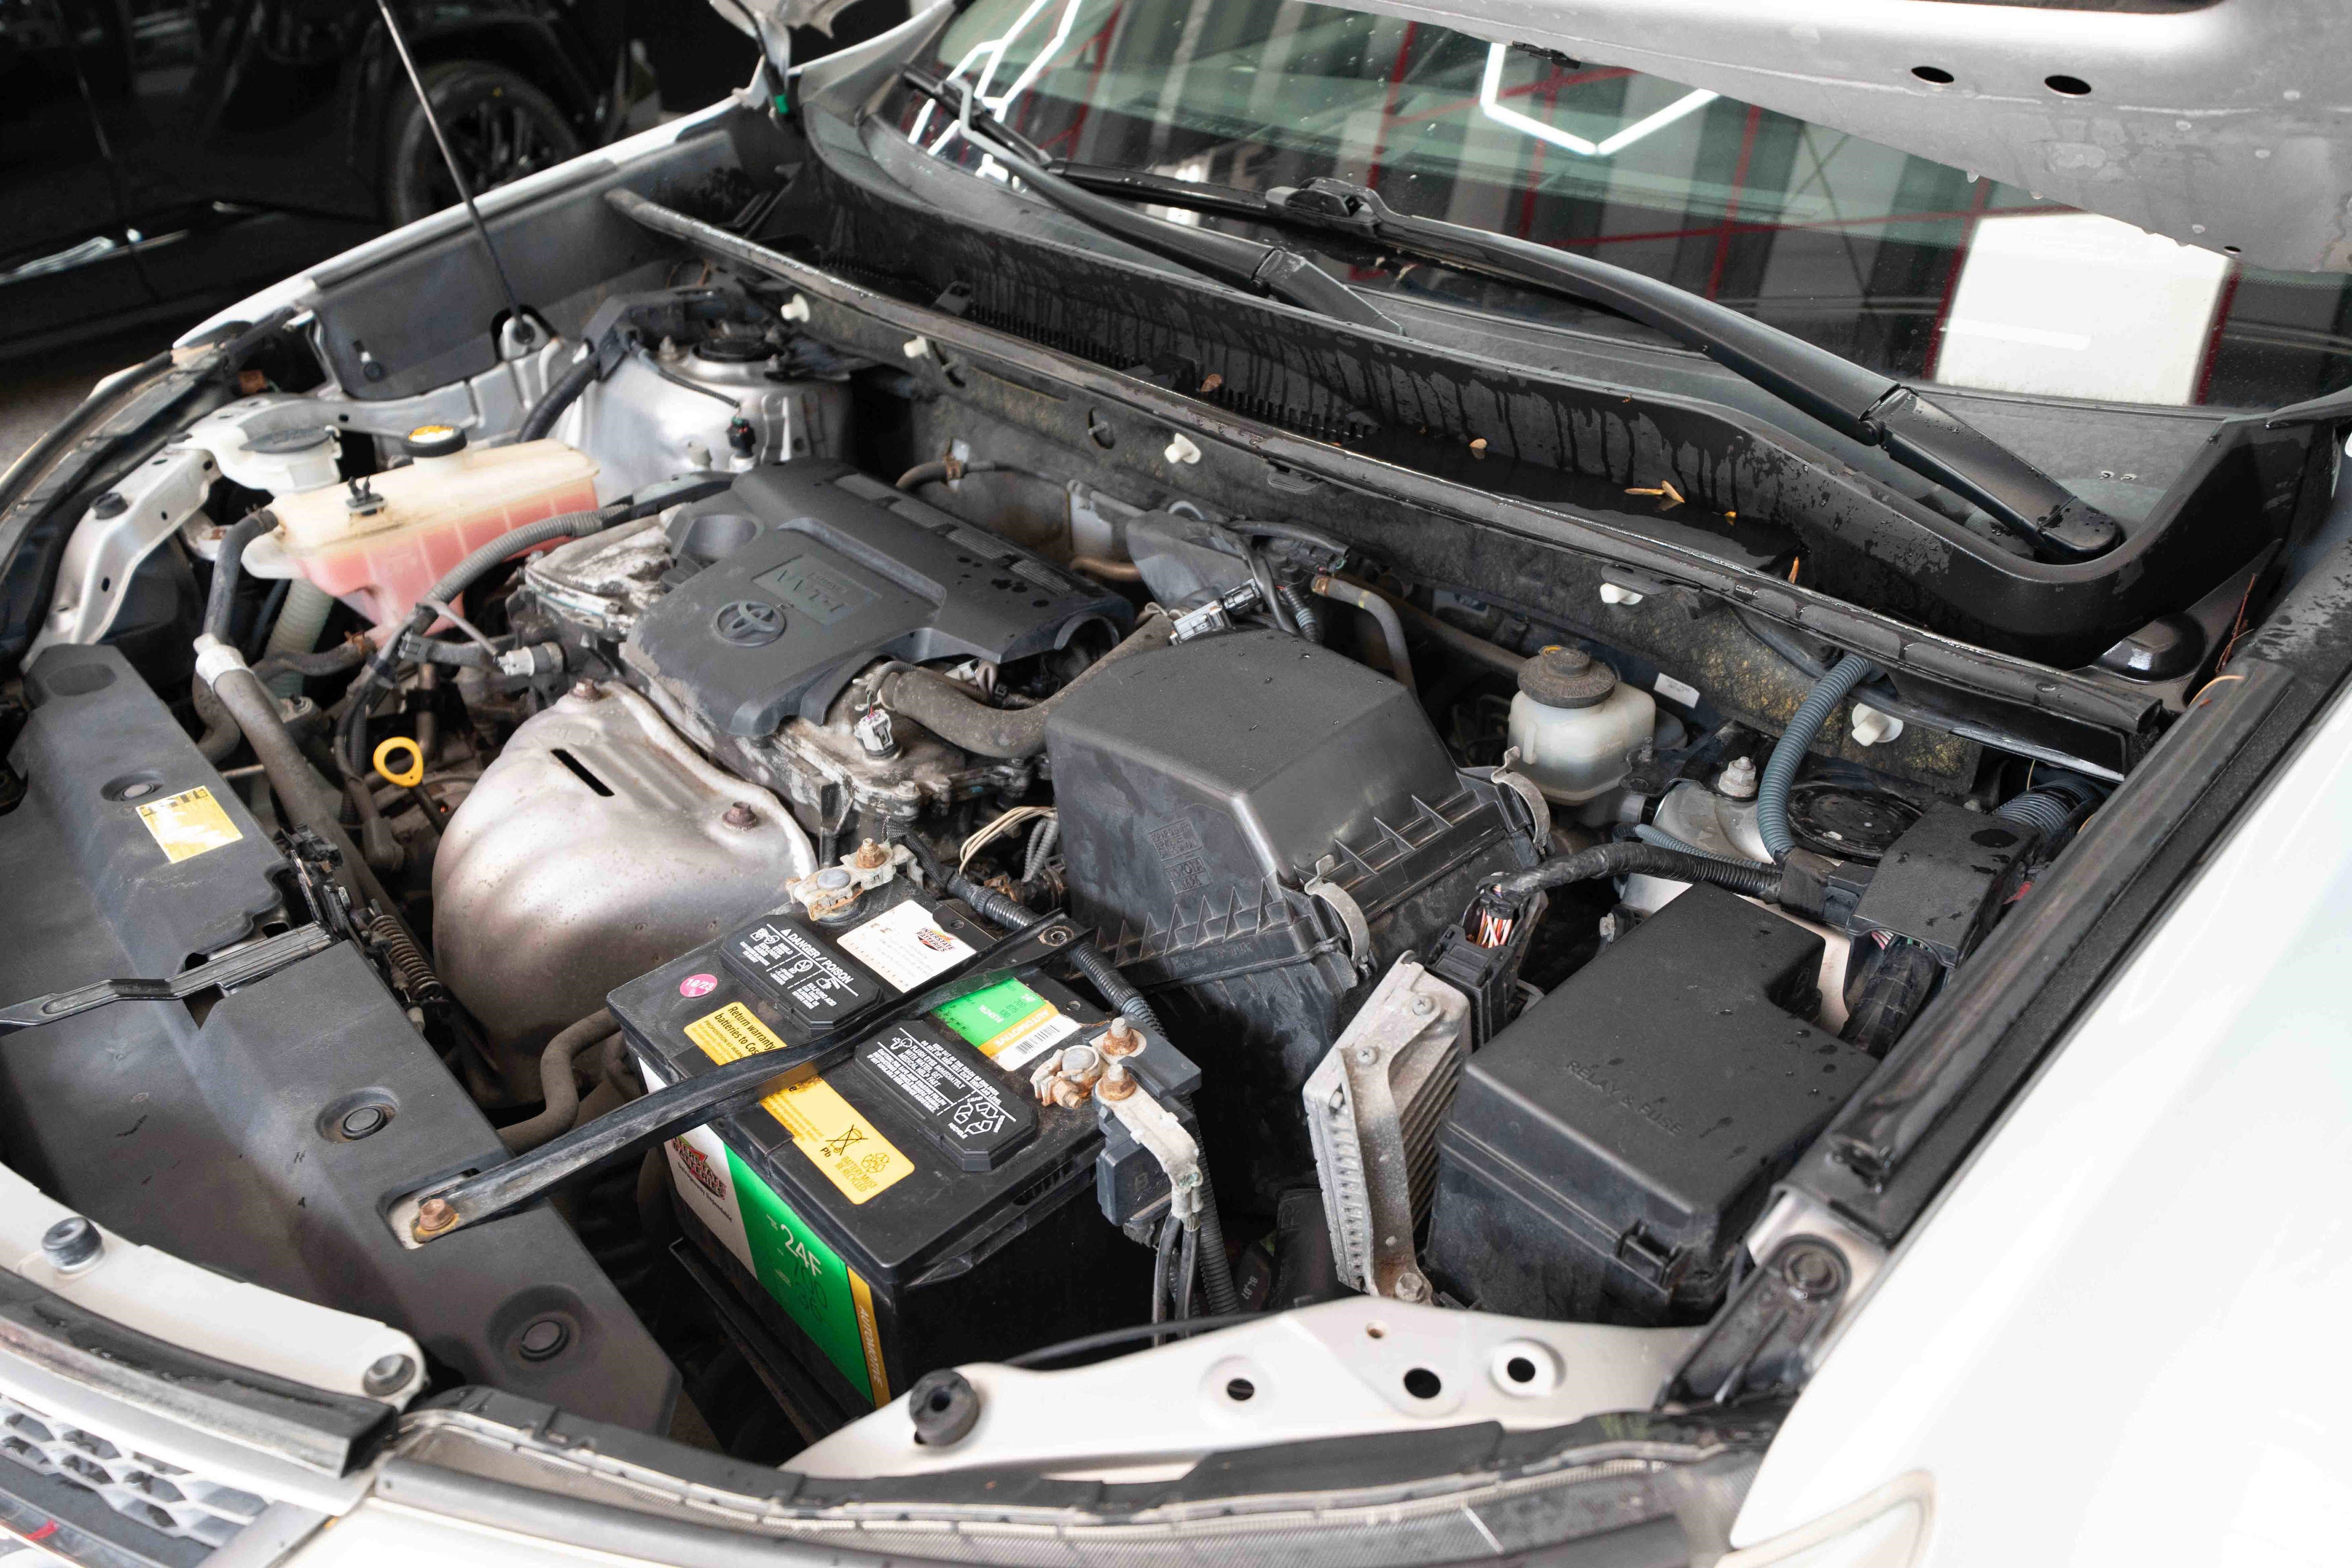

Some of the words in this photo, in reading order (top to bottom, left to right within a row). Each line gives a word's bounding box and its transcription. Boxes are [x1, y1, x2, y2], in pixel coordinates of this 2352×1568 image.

[915, 930, 947, 953] BATTERIES
[921, 926, 955, 951] INTERSTATE
[787, 933, 820, 958] DANGER
[821, 960, 854, 984] POISON
[728, 1007, 750, 1026] Return
[747, 1025, 775, 1051] warranty
[993, 1010, 1049, 1047] AUTOMOTIVE
[996, 1009, 1012, 1018] 130
[704, 1021, 728, 1042] PROPOSITION
[731, 1047, 743, 1058] WARN
[715, 1013, 742, 1038] batteries
[746, 1043, 761, 1055] Cos
[898, 1053, 921, 1070] MEDICAL
[915, 1067, 930, 1077] HELP
[926, 1076, 941, 1087] FAST
[904, 1049, 918, 1060] WITH
[931, 1071, 943, 1080] GET
[910, 1045, 927, 1058] FLUSH
[924, 1056, 938, 1067] EYES
[934, 1065, 966, 1089] IMMEDIATELY
[1566, 1060, 1621, 1095] RELAY
[1621, 1095, 1635, 1108] &
[1637, 1102, 1684, 1136] FUSE
[821, 1147, 831, 1157] Pb
[841, 1156, 864, 1175] BATTERY
[861, 1174, 877, 1188] MUST
[842, 1168, 867, 1192] RECYCLED
[780, 1224, 822, 1276] 24F
[859, 1305, 882, 1388] AUTOMOTIVE
